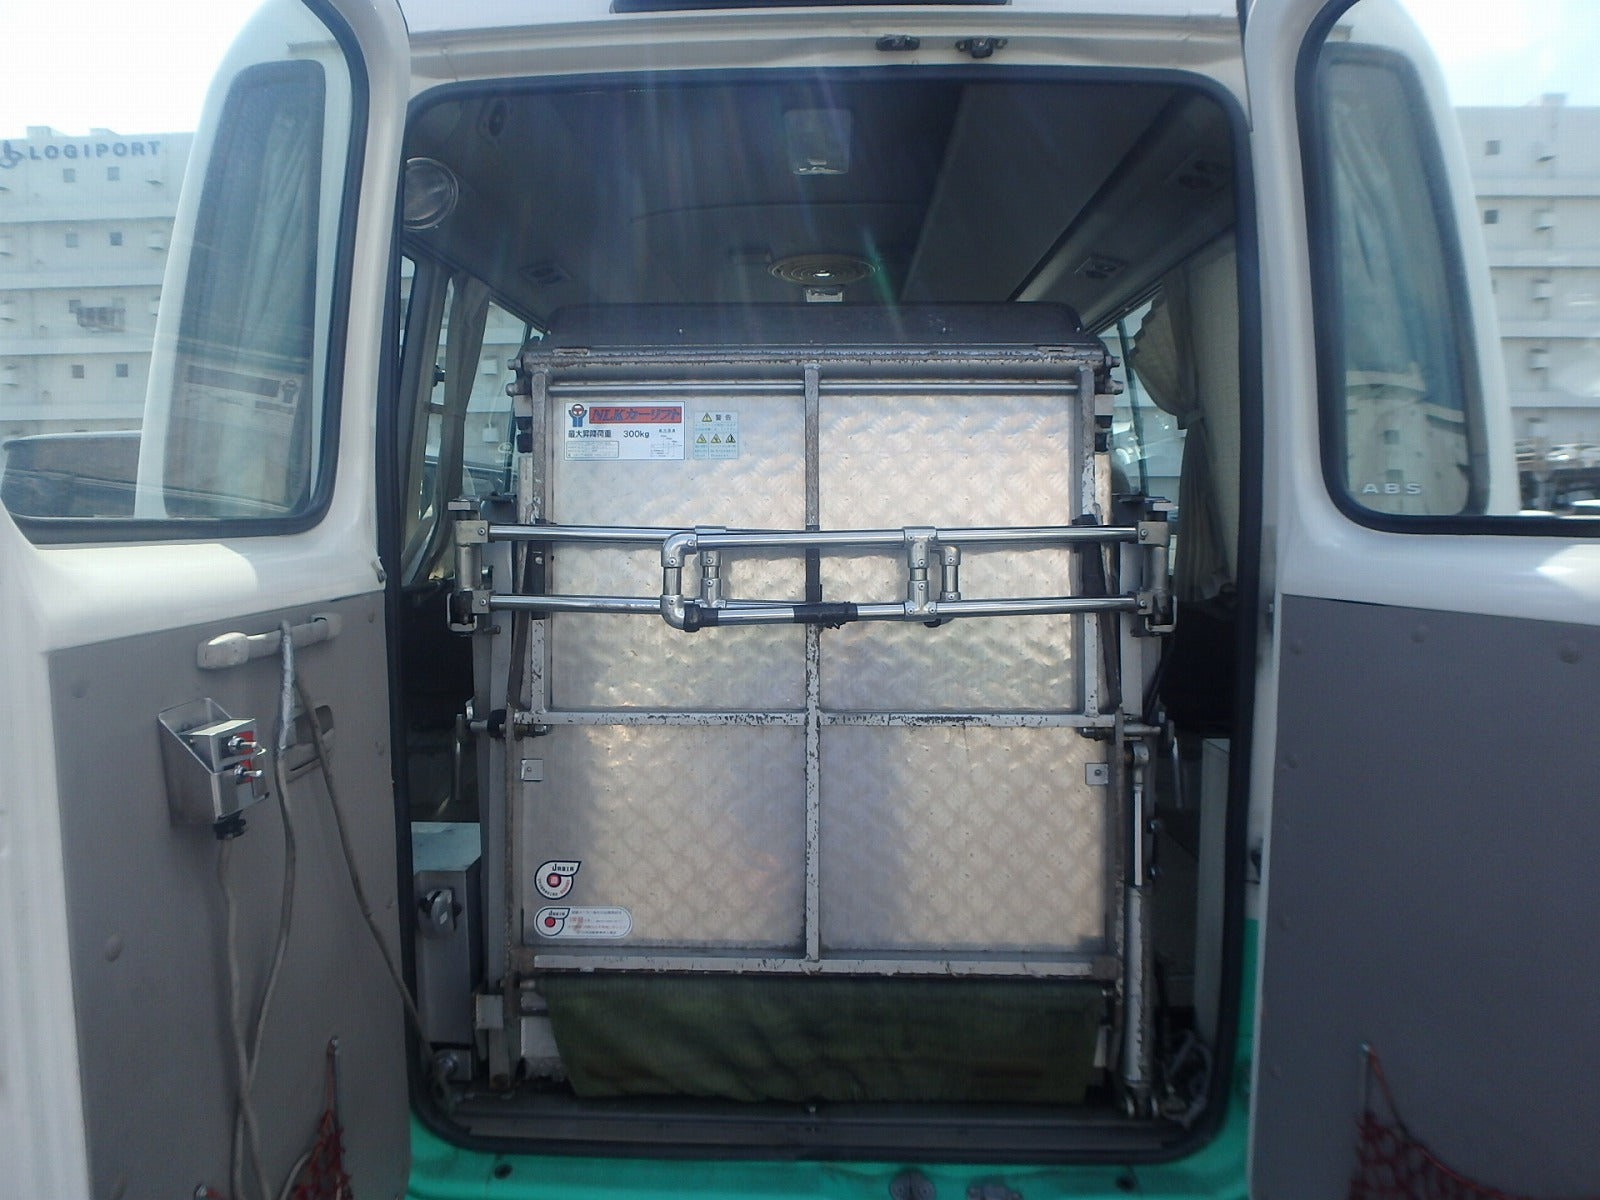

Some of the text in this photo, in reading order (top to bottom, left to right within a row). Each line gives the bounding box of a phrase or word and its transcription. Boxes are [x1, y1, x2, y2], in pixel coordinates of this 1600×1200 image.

[29, 141, 161, 160] LOGIPORT
[623, 430, 650, 438] 300kg
[1362, 483, 1421, 494] ABS
